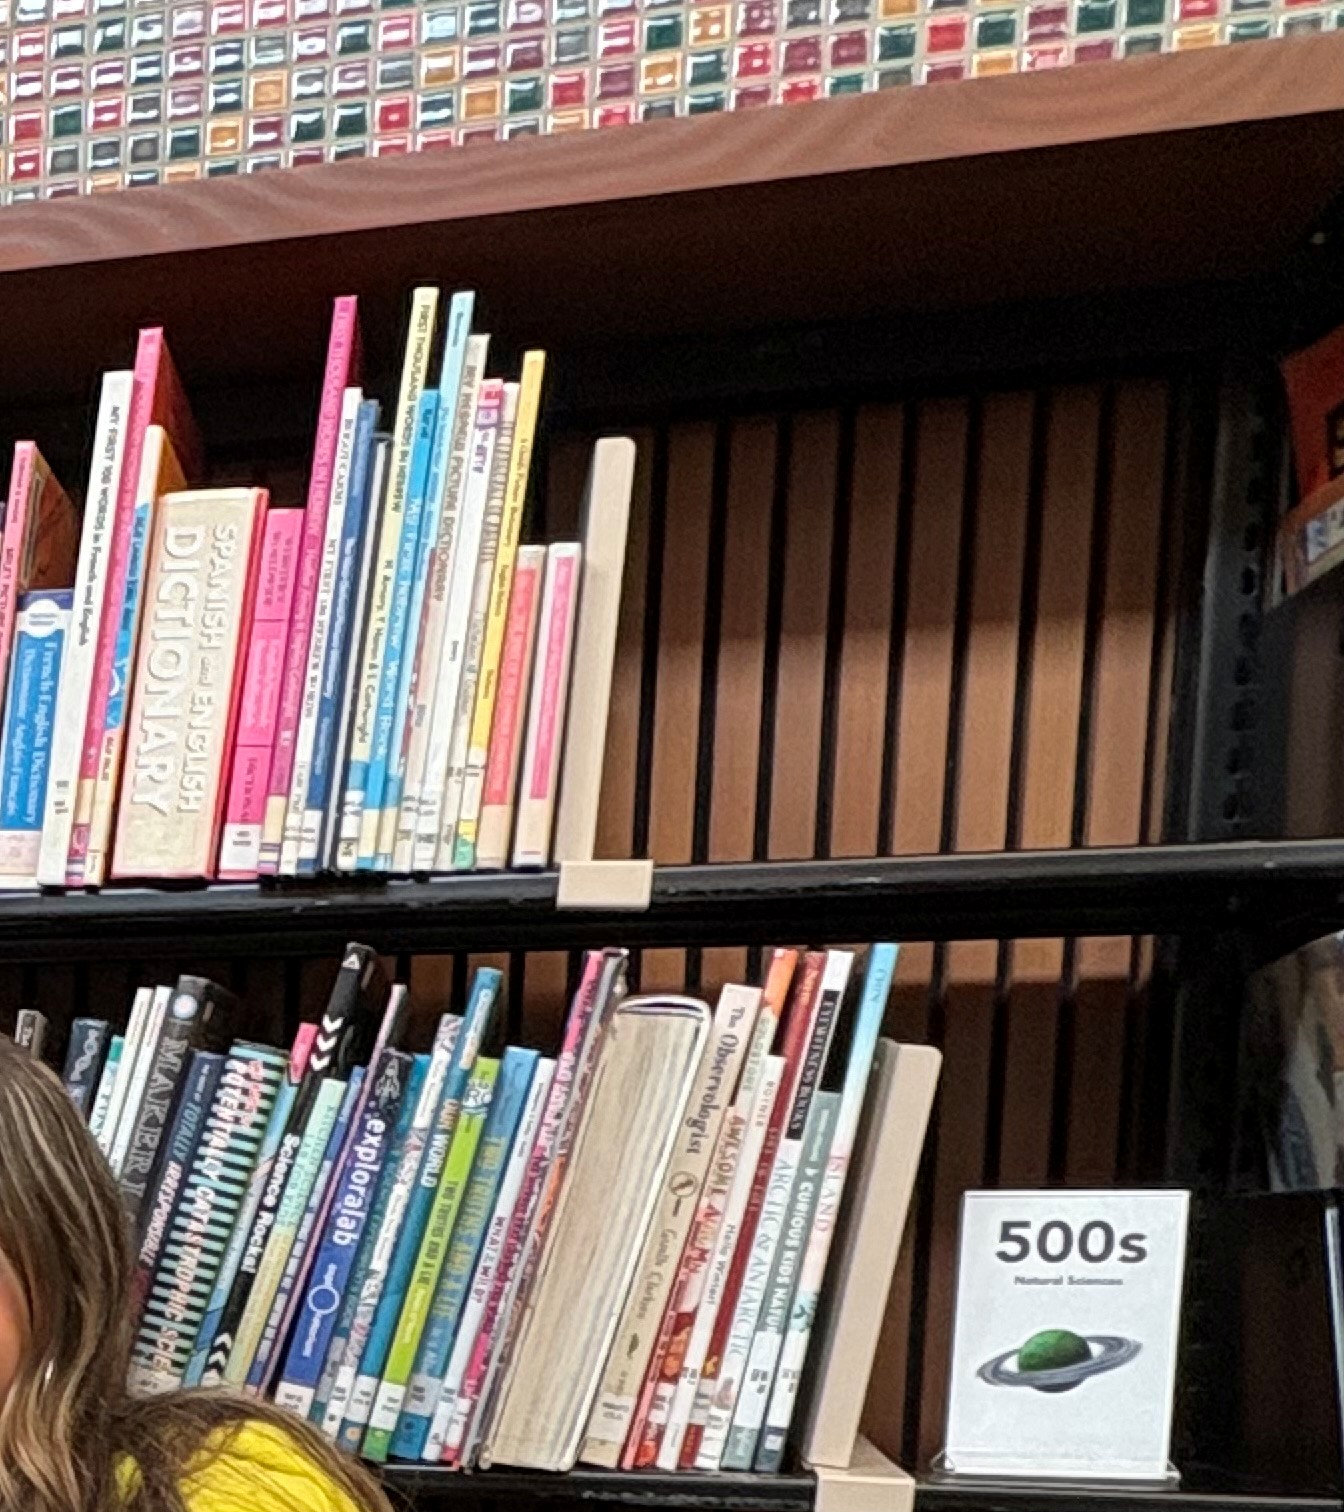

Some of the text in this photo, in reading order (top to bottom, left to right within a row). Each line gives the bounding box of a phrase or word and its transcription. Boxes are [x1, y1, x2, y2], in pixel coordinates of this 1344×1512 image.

[101, 427, 118, 461] FIRST
[197, 524, 240, 650] SPANISH
[429, 514, 457, 603] DICTIONARY
[75, 607, 92, 646] English
[127, 523, 208, 815] DICTIONARY
[176, 687, 217, 815] ENGLISH
[131, 1035, 182, 1177] MAKER
[198, 1057, 249, 1180] POTENTIALLY
[680, 1004, 750, 1158] The Observologist
[167, 1101, 201, 1163] TOTALLY
[259, 1131, 302, 1209] Science
[418, 1129, 451, 1190] WORLD
[323, 1114, 396, 1249] exploralab
[782, 1179, 815, 1249] CURIOUS
[165, 1184, 217, 1323] CATASTROPHIC
[727, 1158, 794, 1359] ARCTIC & ANTARCTIC
[773, 1248, 800, 1286] KIDS
[995, 1219, 1149, 1265] 500s
[1014, 1274, 1125, 1287] Natural Sciences
